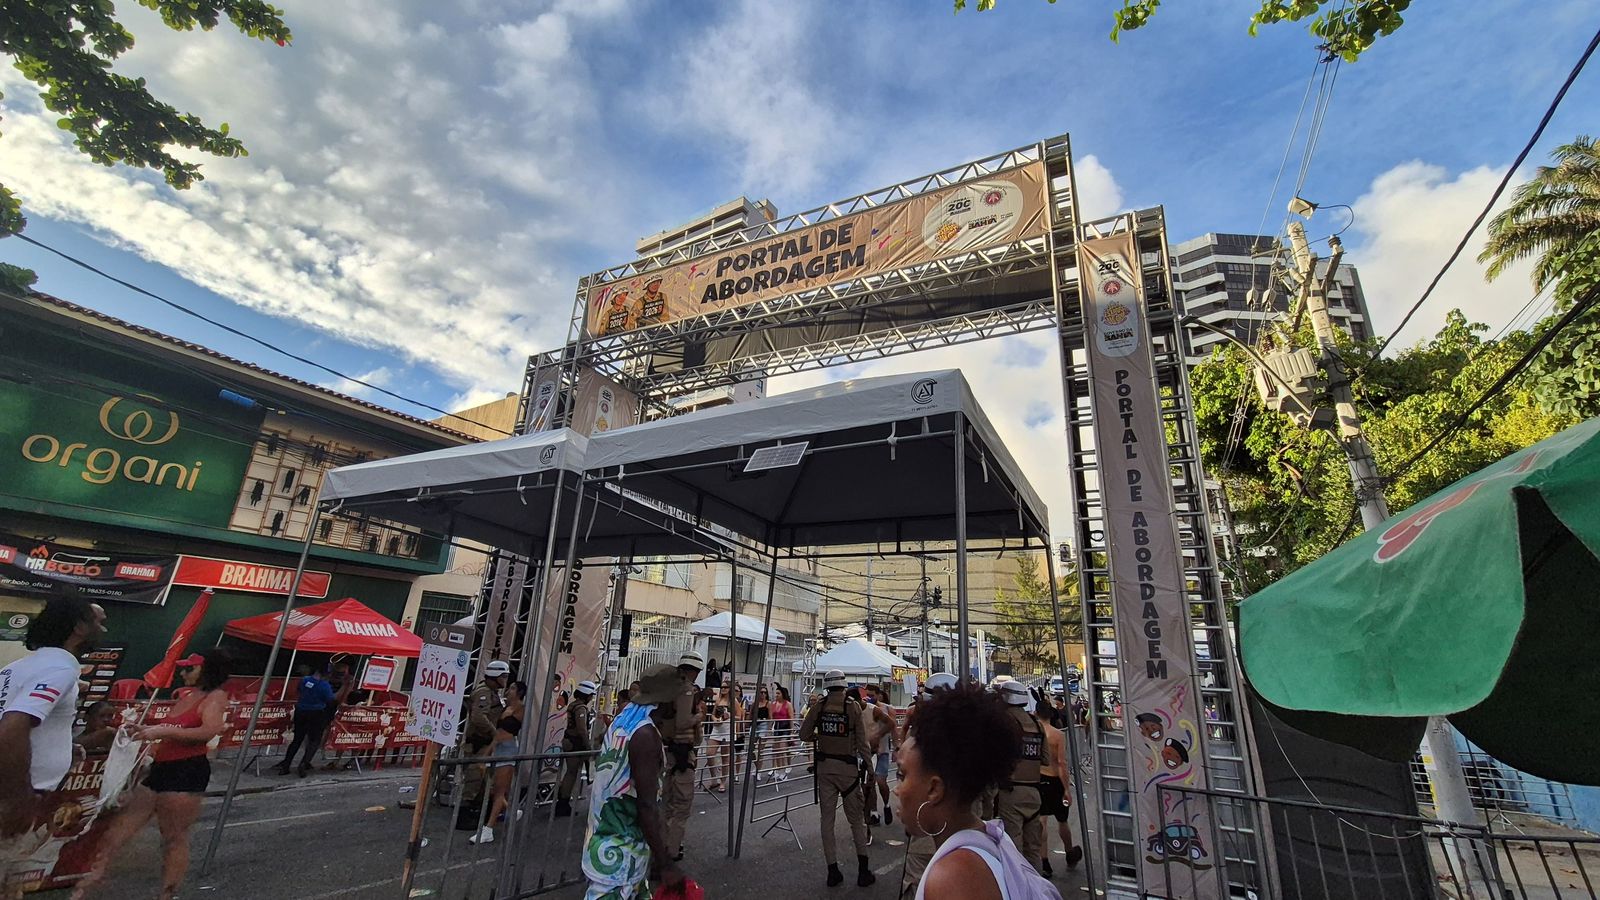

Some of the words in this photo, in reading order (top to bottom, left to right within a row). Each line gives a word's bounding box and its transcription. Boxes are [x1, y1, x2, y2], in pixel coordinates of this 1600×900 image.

[716, 235, 813, 278] PORTAL
[819, 223, 854, 251] DE
[701, 244, 866, 305] ABORDAGEM
[1115, 370, 1138, 460] PORTAL
[22, 434, 202, 491] organi
[1126, 469, 1142, 502] DE
[120, 566, 156, 578] BRAHMA
[220, 564, 291, 591] BRAHMA
[558, 558, 583, 654] BORDAGEM
[1132, 512, 1168, 680] ABORDAGEM
[332, 618, 398, 638] BRAHMA
[420, 665, 456, 694] SAÍDA
[420, 698, 446, 720] EXIT
[61, 774, 104, 792] ABER
